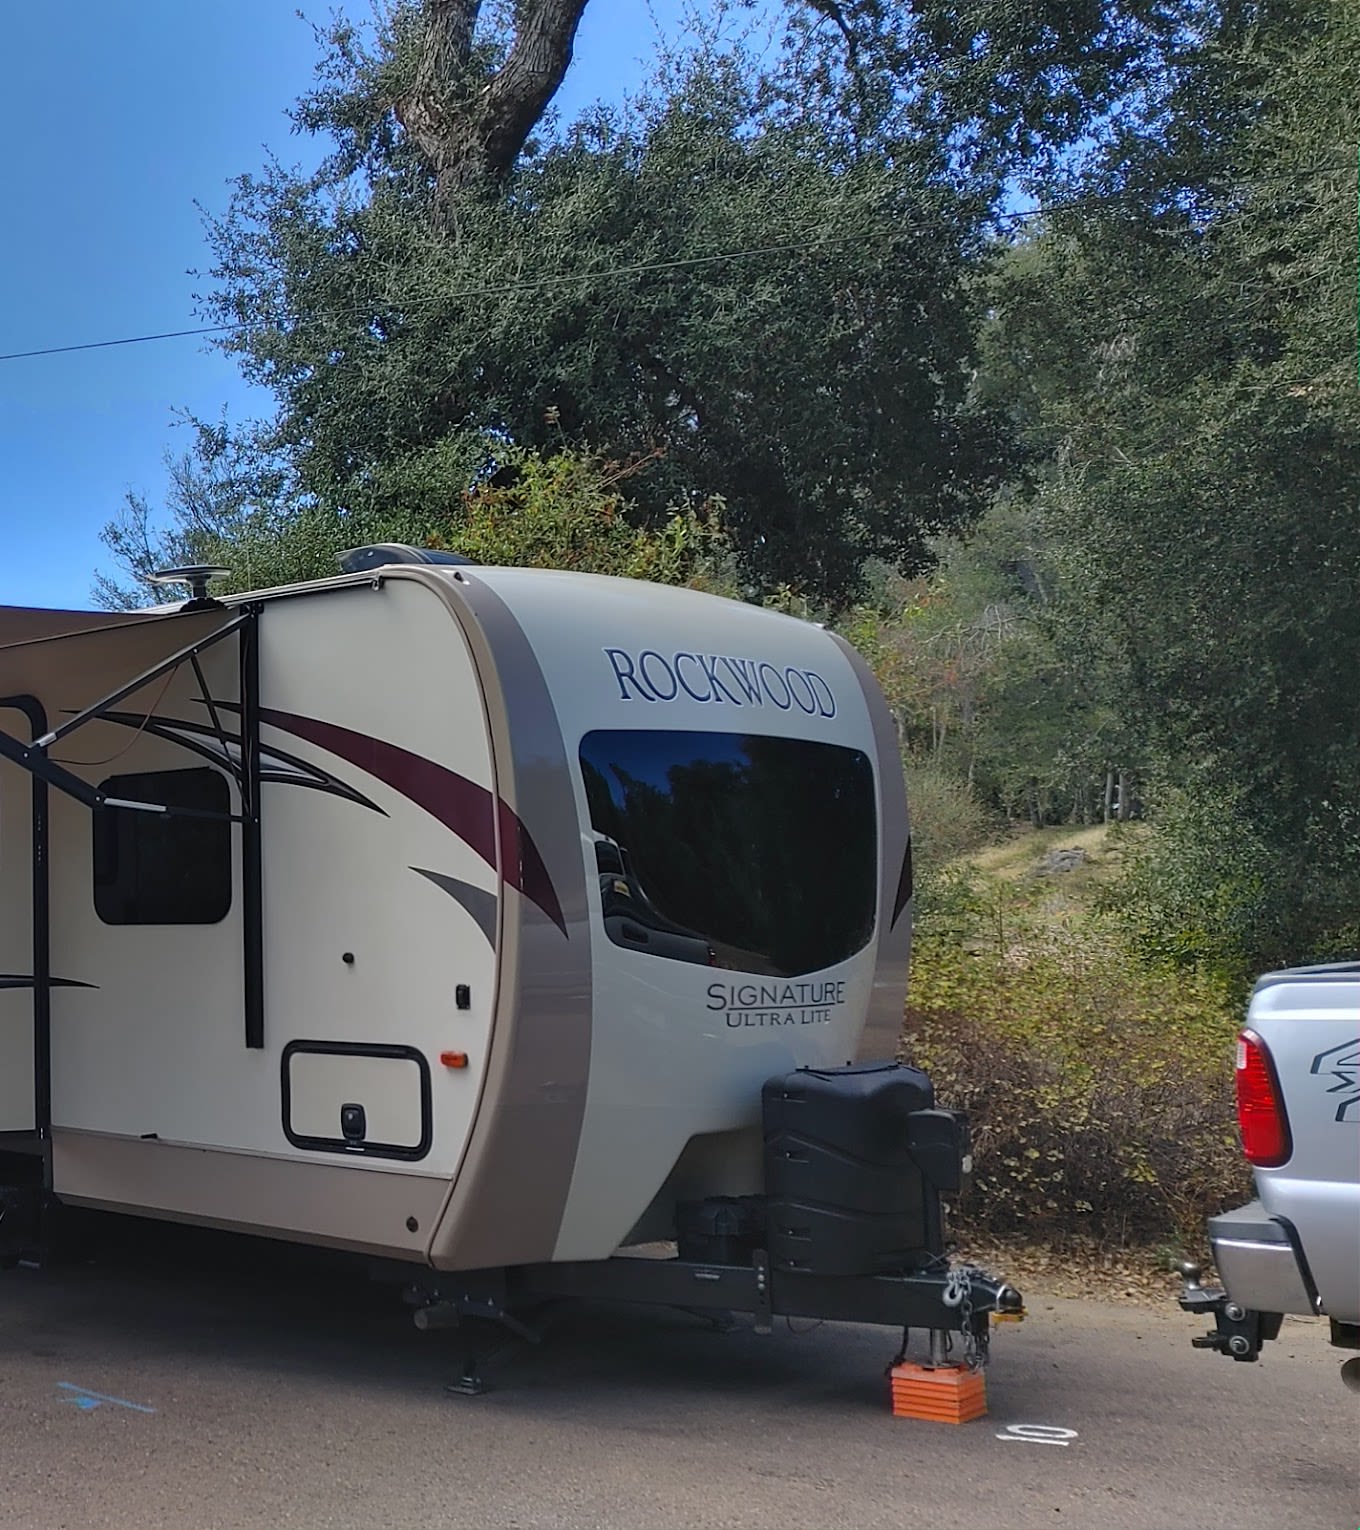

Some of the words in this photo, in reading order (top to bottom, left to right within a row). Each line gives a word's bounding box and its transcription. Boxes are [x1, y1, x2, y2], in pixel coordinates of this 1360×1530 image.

[602, 647, 837, 719] ROCKWOOD
[706, 981, 846, 1011] SIGNATURE
[726, 1011, 796, 1028] ULTRA
[801, 1009, 832, 1026] LITE
